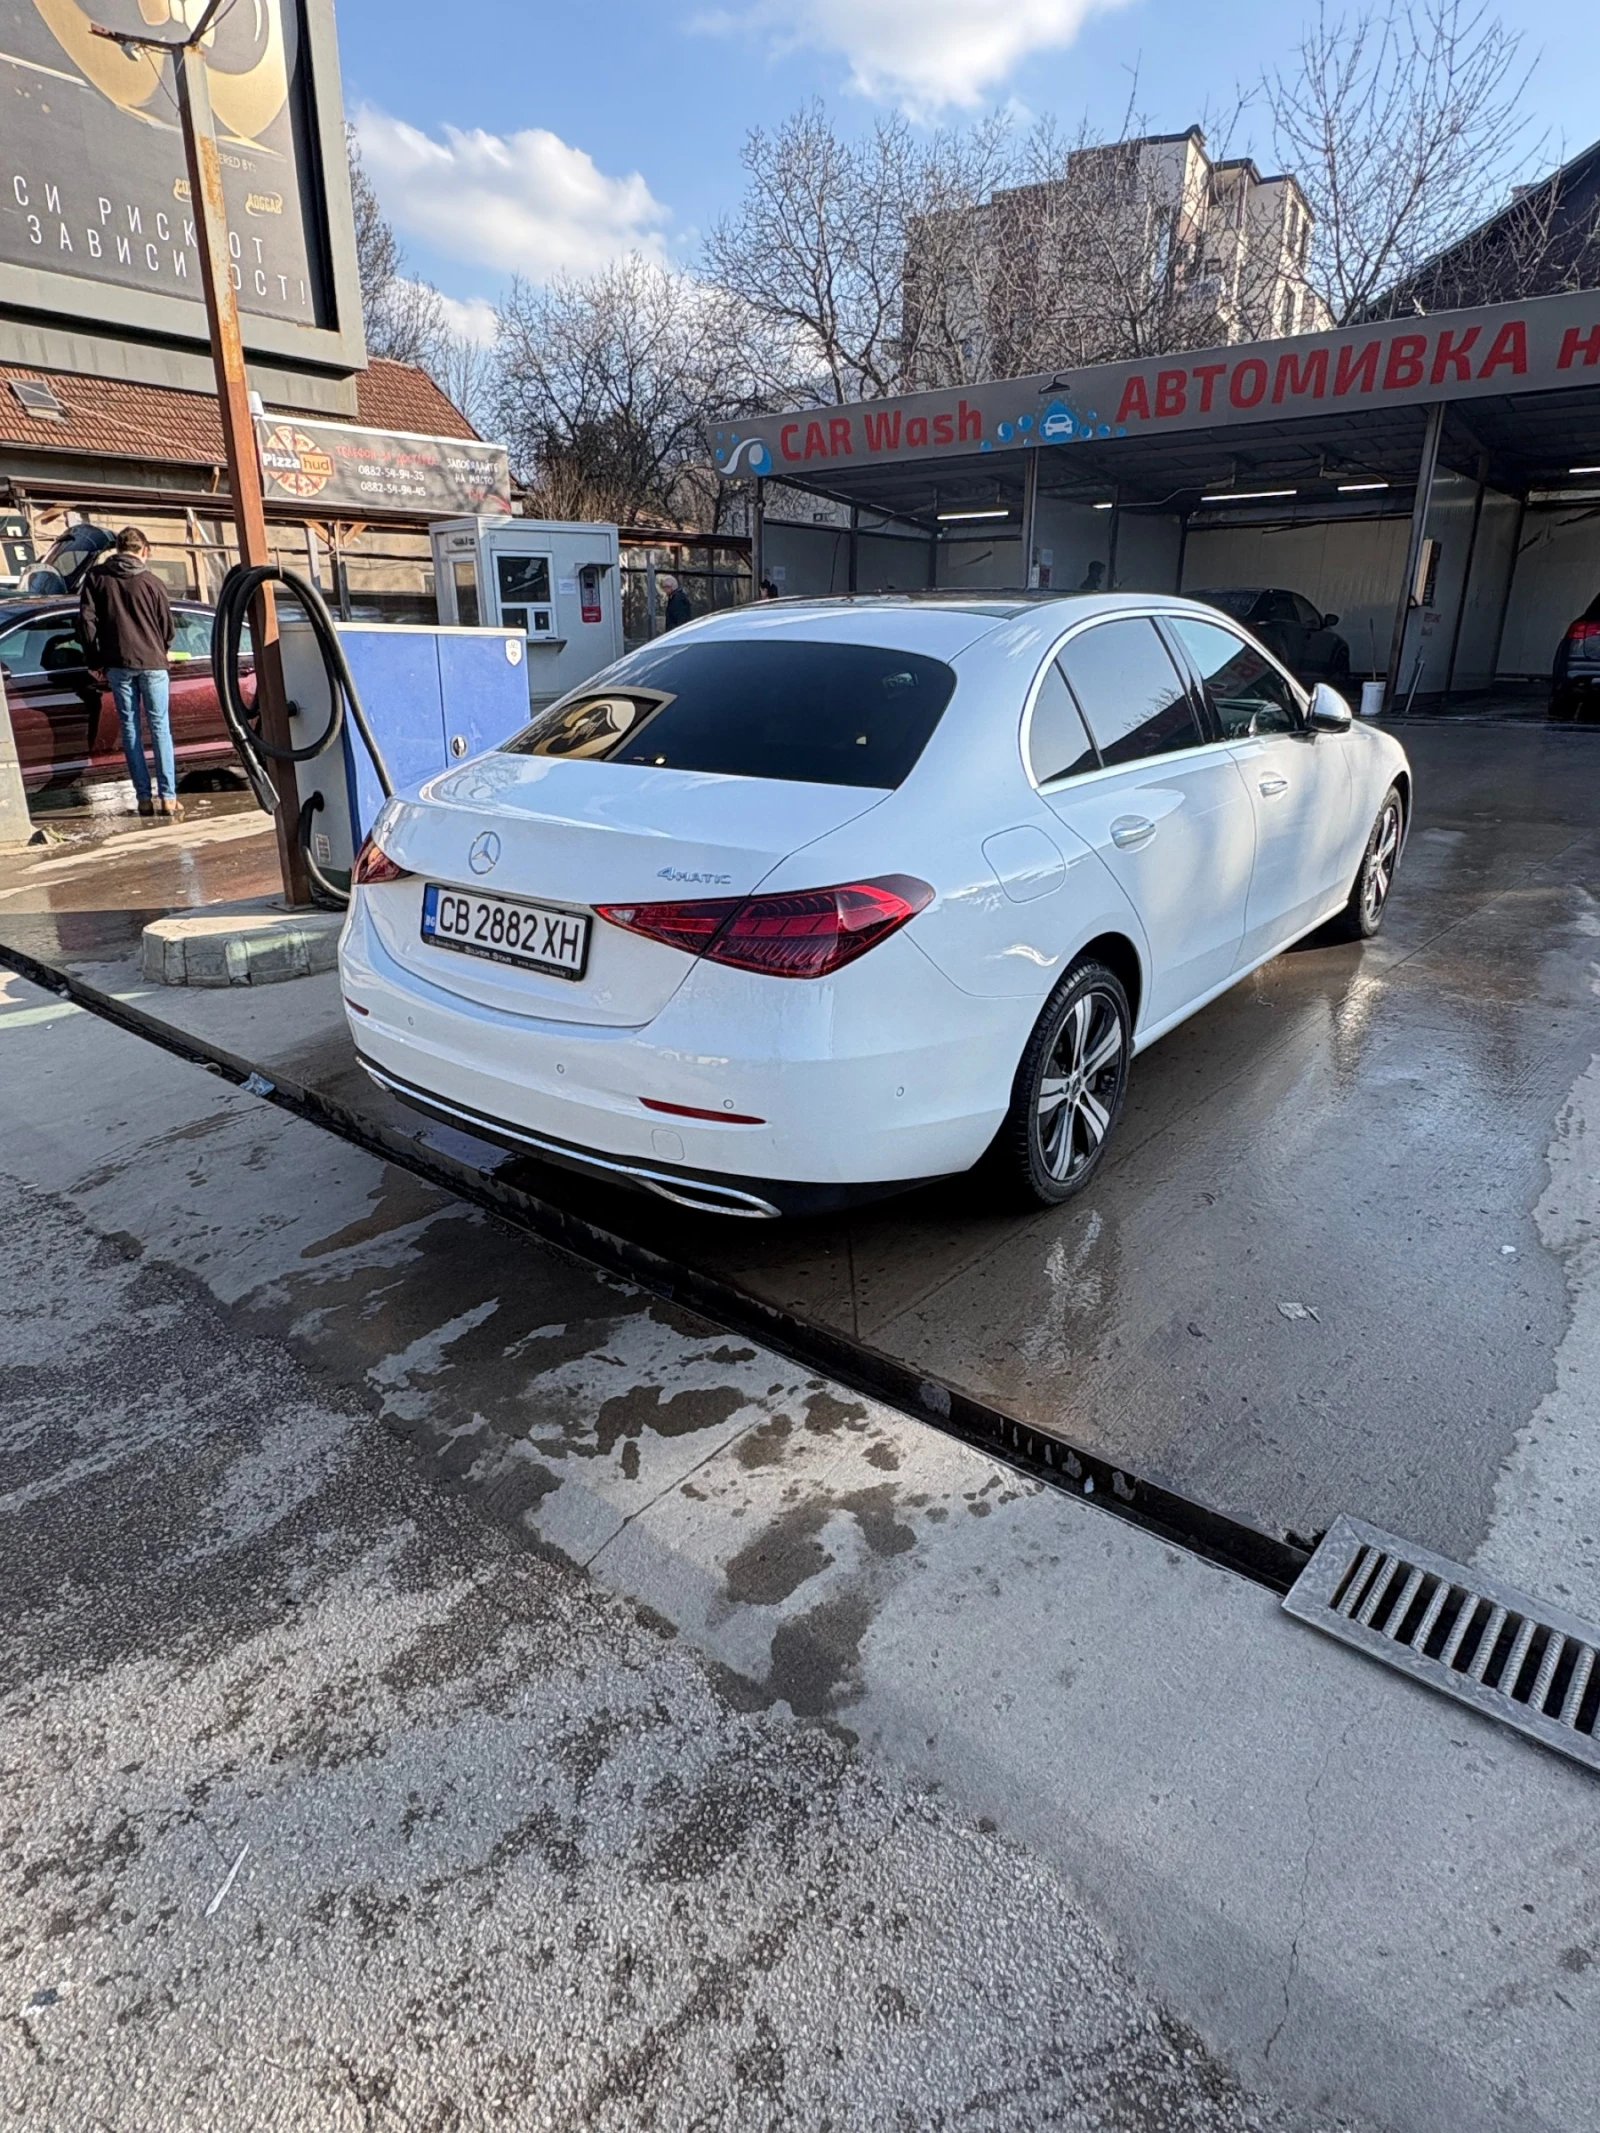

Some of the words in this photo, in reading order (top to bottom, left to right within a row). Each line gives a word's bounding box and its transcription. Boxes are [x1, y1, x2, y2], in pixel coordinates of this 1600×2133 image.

[218, 153, 241, 169] ERED
[13, 175, 62, 215] СИ
[99, 196, 198, 248] РИСК
[229, 231, 264, 264] ОТ
[27, 214, 306, 306] ЗАВИСИОСТ!
[1115, 319, 1528, 424] АВТОМИВКА
[780, 417, 853, 461] CAR
[864, 400, 982, 452] Wash
[262, 453, 301, 469] Pizza
[303, 457, 330, 471] hud
[455, 473, 467, 484] НА
[656, 866, 732, 885] 4MATIC
[425, 914, 436, 928] BG
[440, 896, 470, 936] CB
[474, 903, 538, 953] 2882
[541, 917, 580, 963] XH
